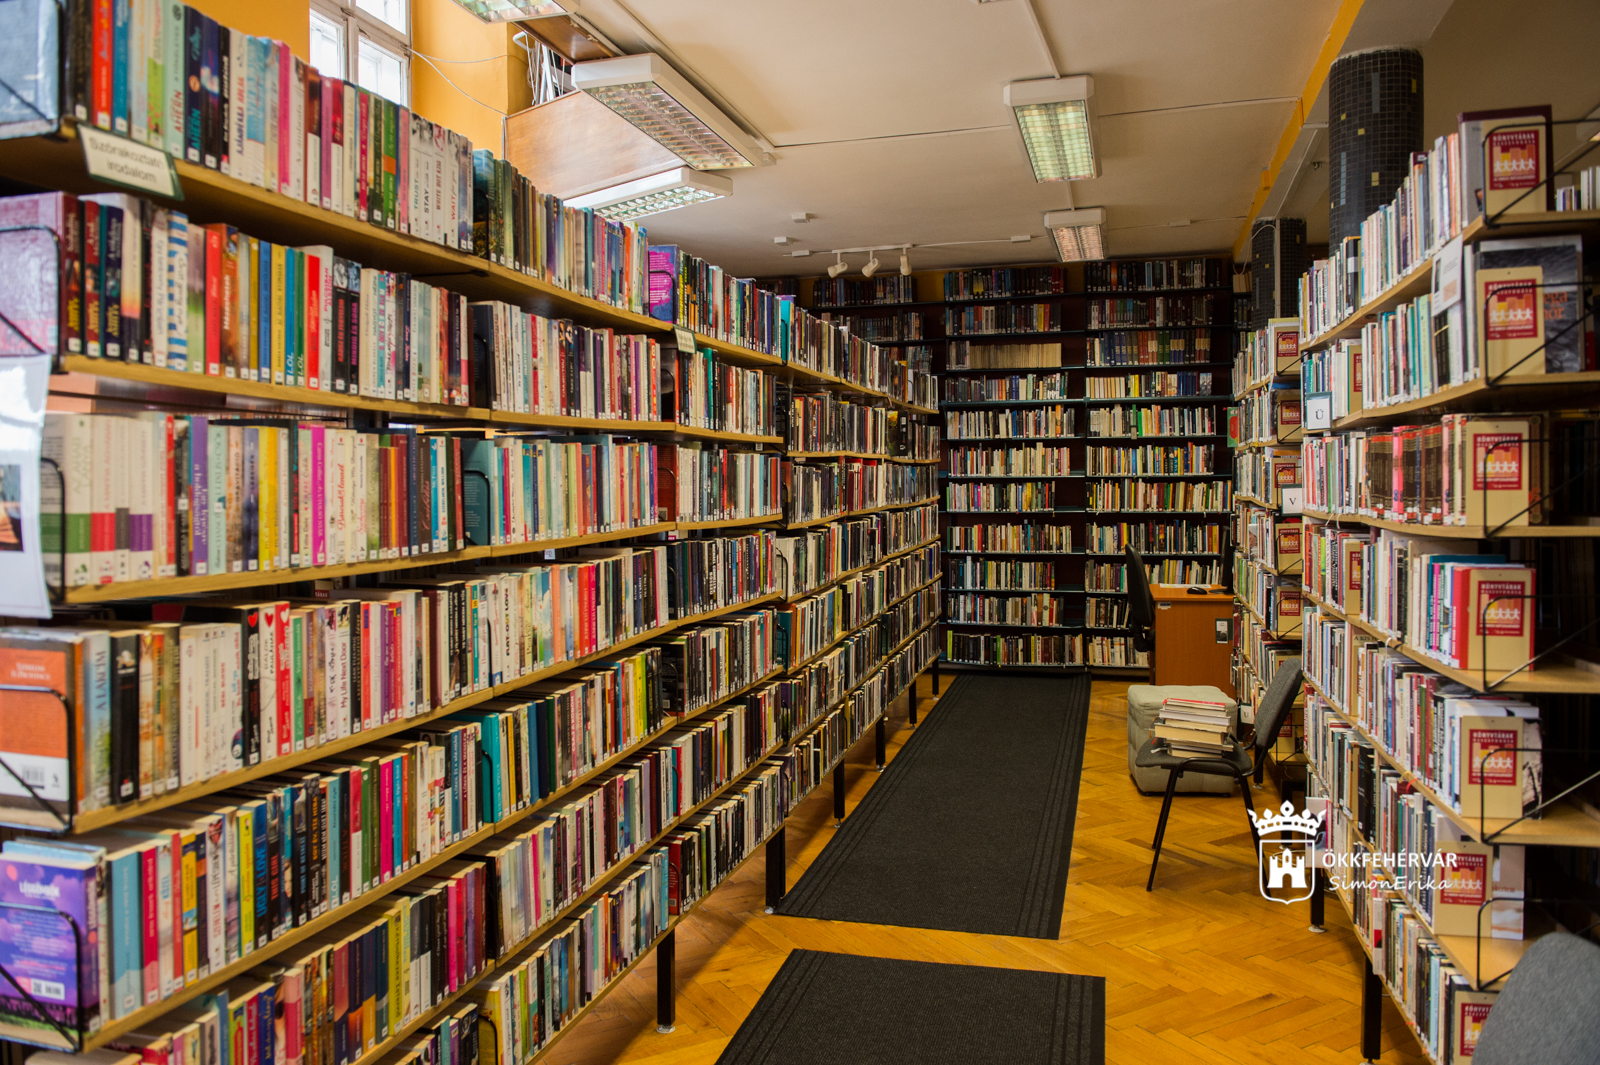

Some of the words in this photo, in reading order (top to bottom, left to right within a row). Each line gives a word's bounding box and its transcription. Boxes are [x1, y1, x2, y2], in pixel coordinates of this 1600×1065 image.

[350, 302, 358, 324] SOHA
[350, 325, 358, 335] ÉS
[350, 336, 358, 365] MINDIG
[1315, 409, 1324, 420] Ü
[1288, 497, 1297, 505] V
[339, 642, 347, 661] Door
[94, 651, 106, 699] LAKCÍM
[339, 661, 347, 680] Next
[339, 681, 347, 695] Life
[95, 702, 106, 712] A
[339, 696, 348, 709] My
[255, 844, 267, 879] LOVE
[270, 853, 279, 876] GIRL
[299, 865, 306, 874] OF
[270, 878, 279, 901] THIS
[256, 886, 267, 918] UGLY
